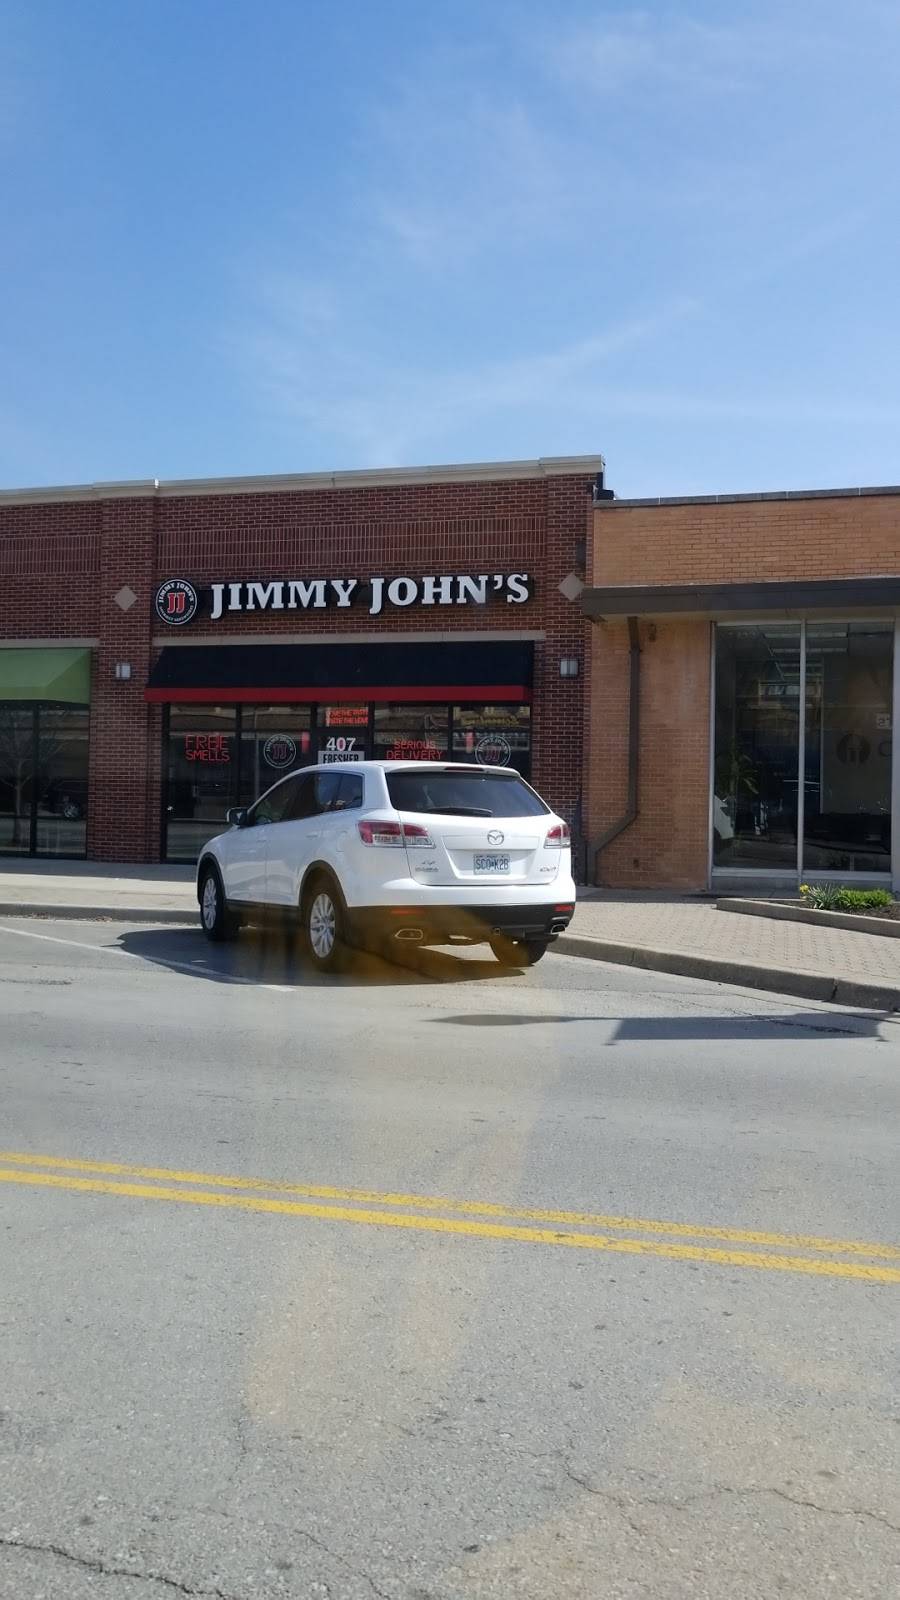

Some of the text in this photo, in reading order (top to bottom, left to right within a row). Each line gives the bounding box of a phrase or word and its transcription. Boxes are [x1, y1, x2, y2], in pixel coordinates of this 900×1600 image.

[210, 580, 358, 620] JIMMY
[369, 573, 529, 615] JOHN'S
[184, 734, 229, 750] FREE
[326, 737, 357, 752] 407
[393, 740, 436, 750] SERIOUS
[185, 750, 231, 761] SMELLS
[386, 750, 443, 760] DELIVERY
